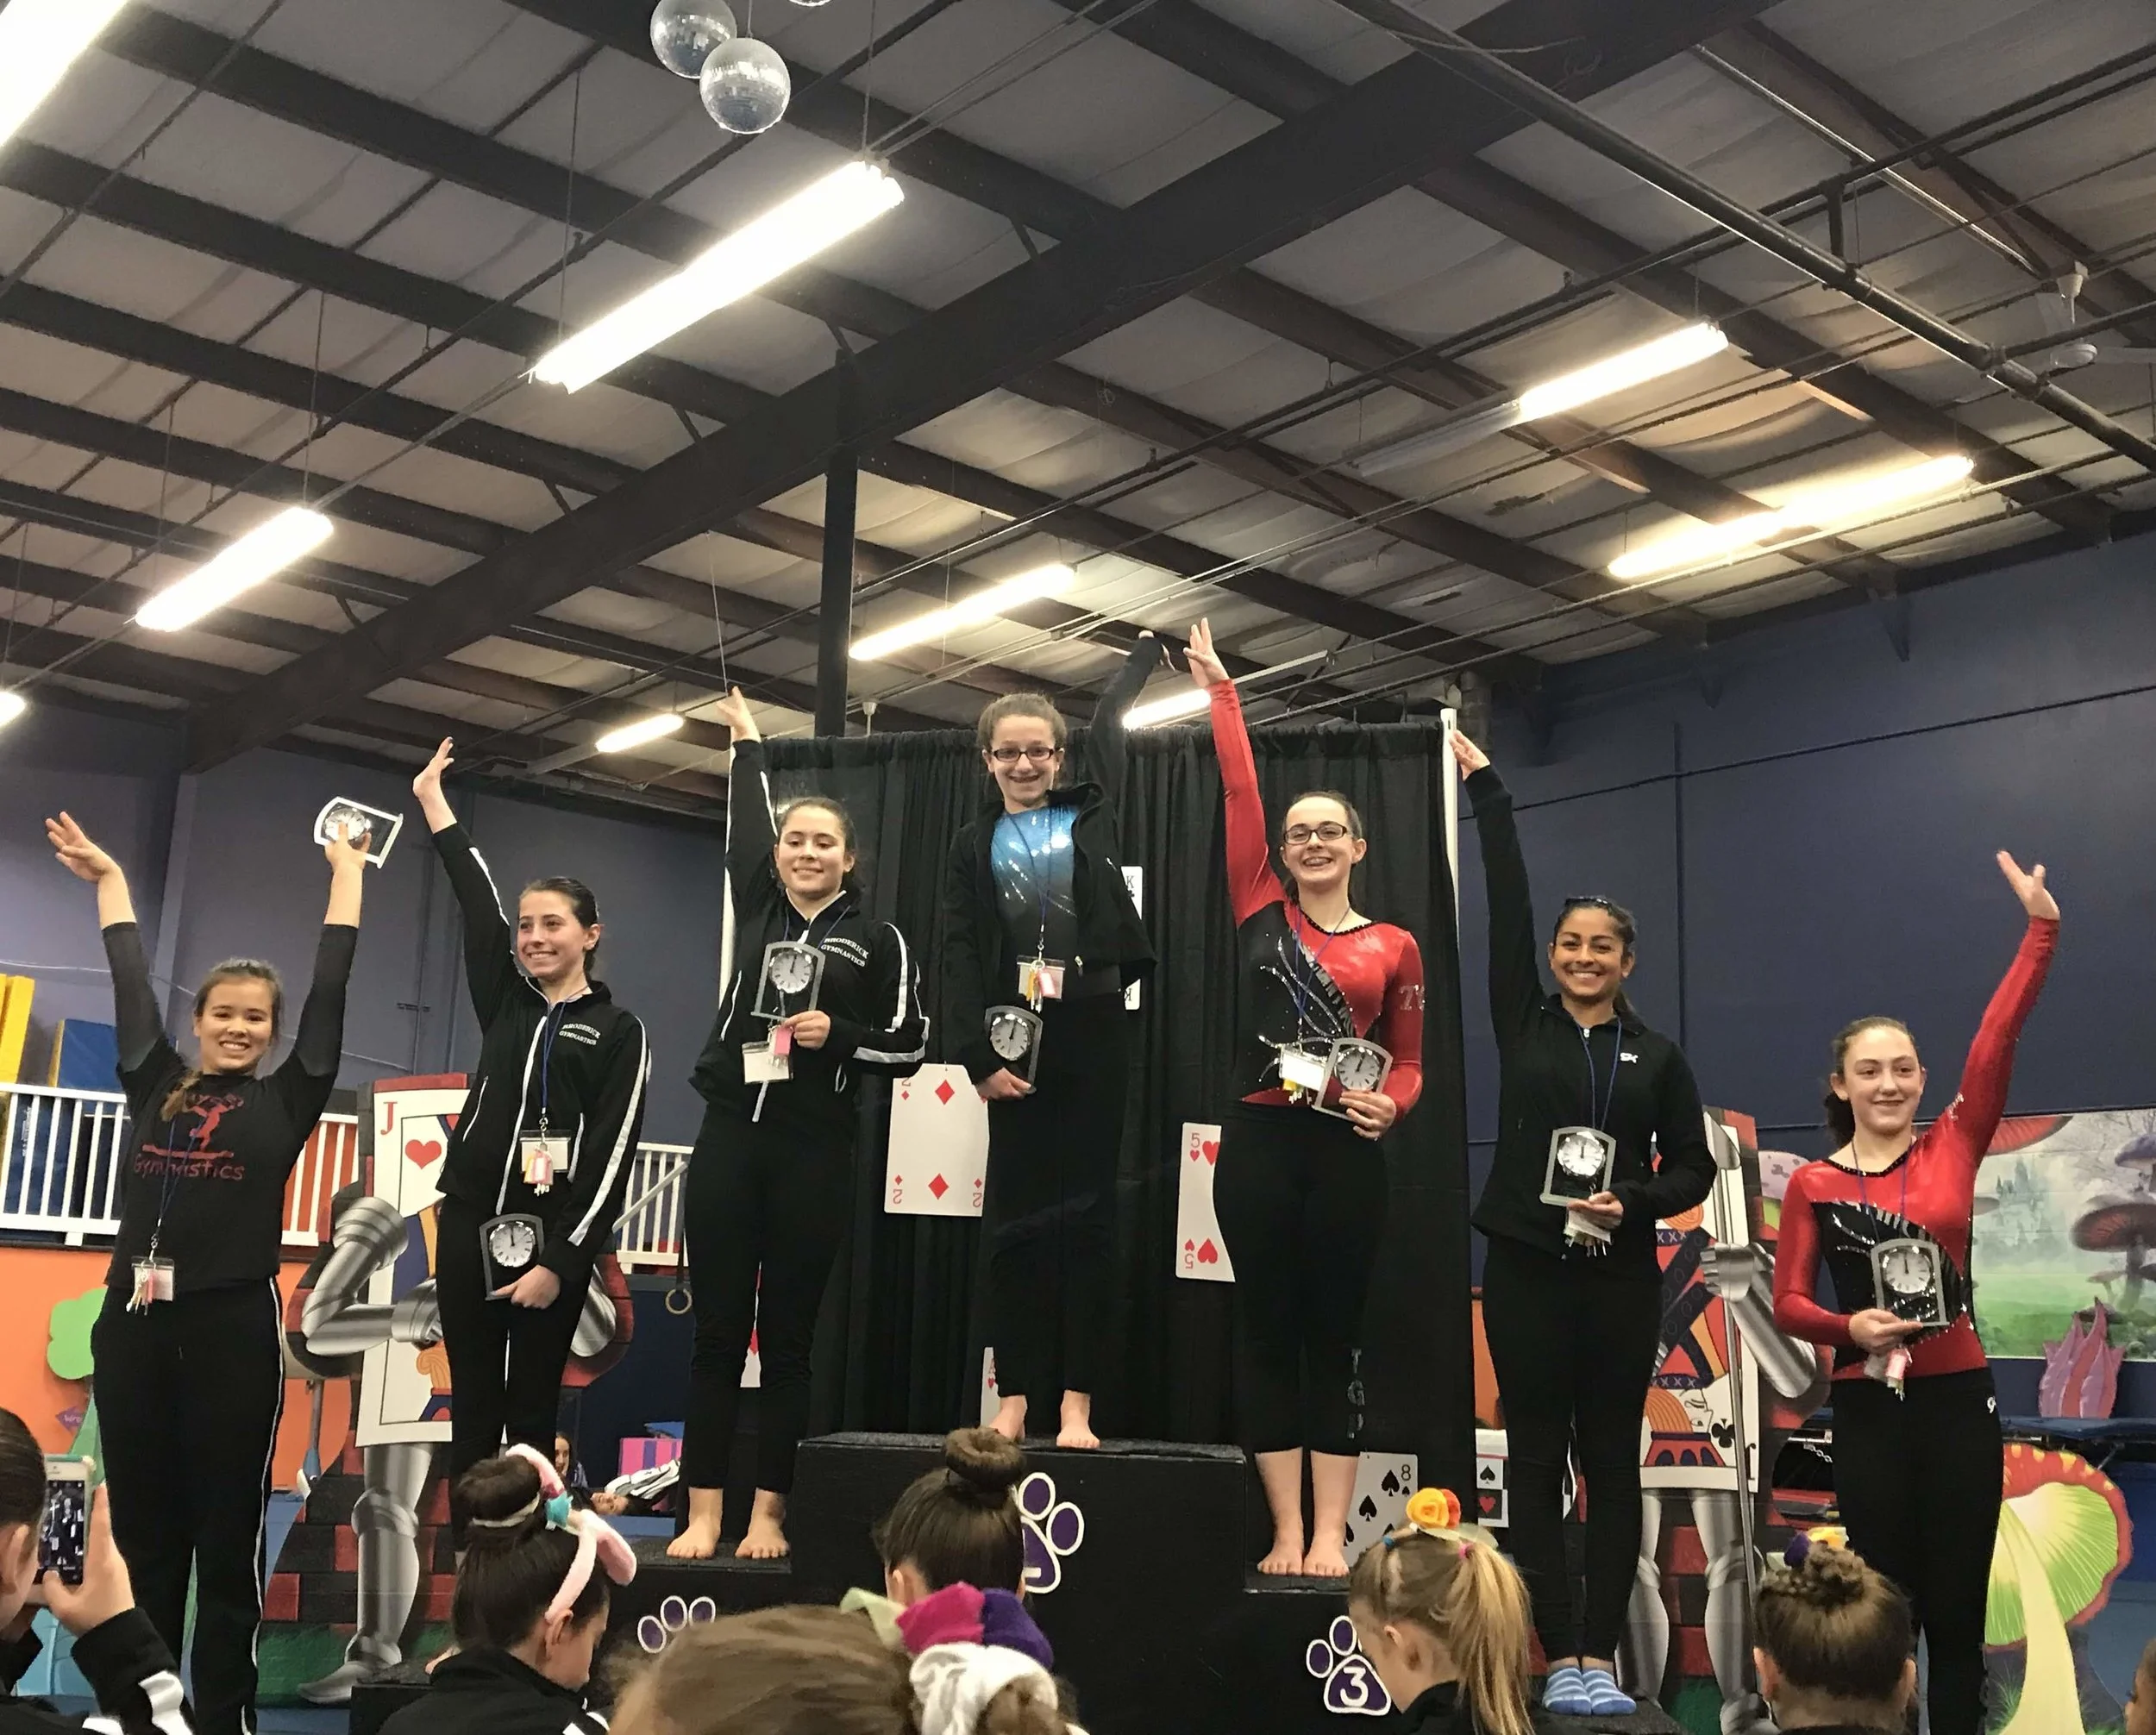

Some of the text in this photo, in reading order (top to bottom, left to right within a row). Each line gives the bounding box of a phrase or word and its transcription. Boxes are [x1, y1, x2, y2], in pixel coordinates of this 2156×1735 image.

[820, 944, 866, 967] GYMNASTICS
[380, 1101, 398, 1135] J
[1190, 1132, 1200, 1149] 5
[893, 1188, 903, 1205] 2
[972, 1193, 982, 1208] 2
[1184, 1253, 1194, 1269] 5
[1401, 1464, 1411, 1481] 8
[1339, 1666, 1369, 1707] 3
